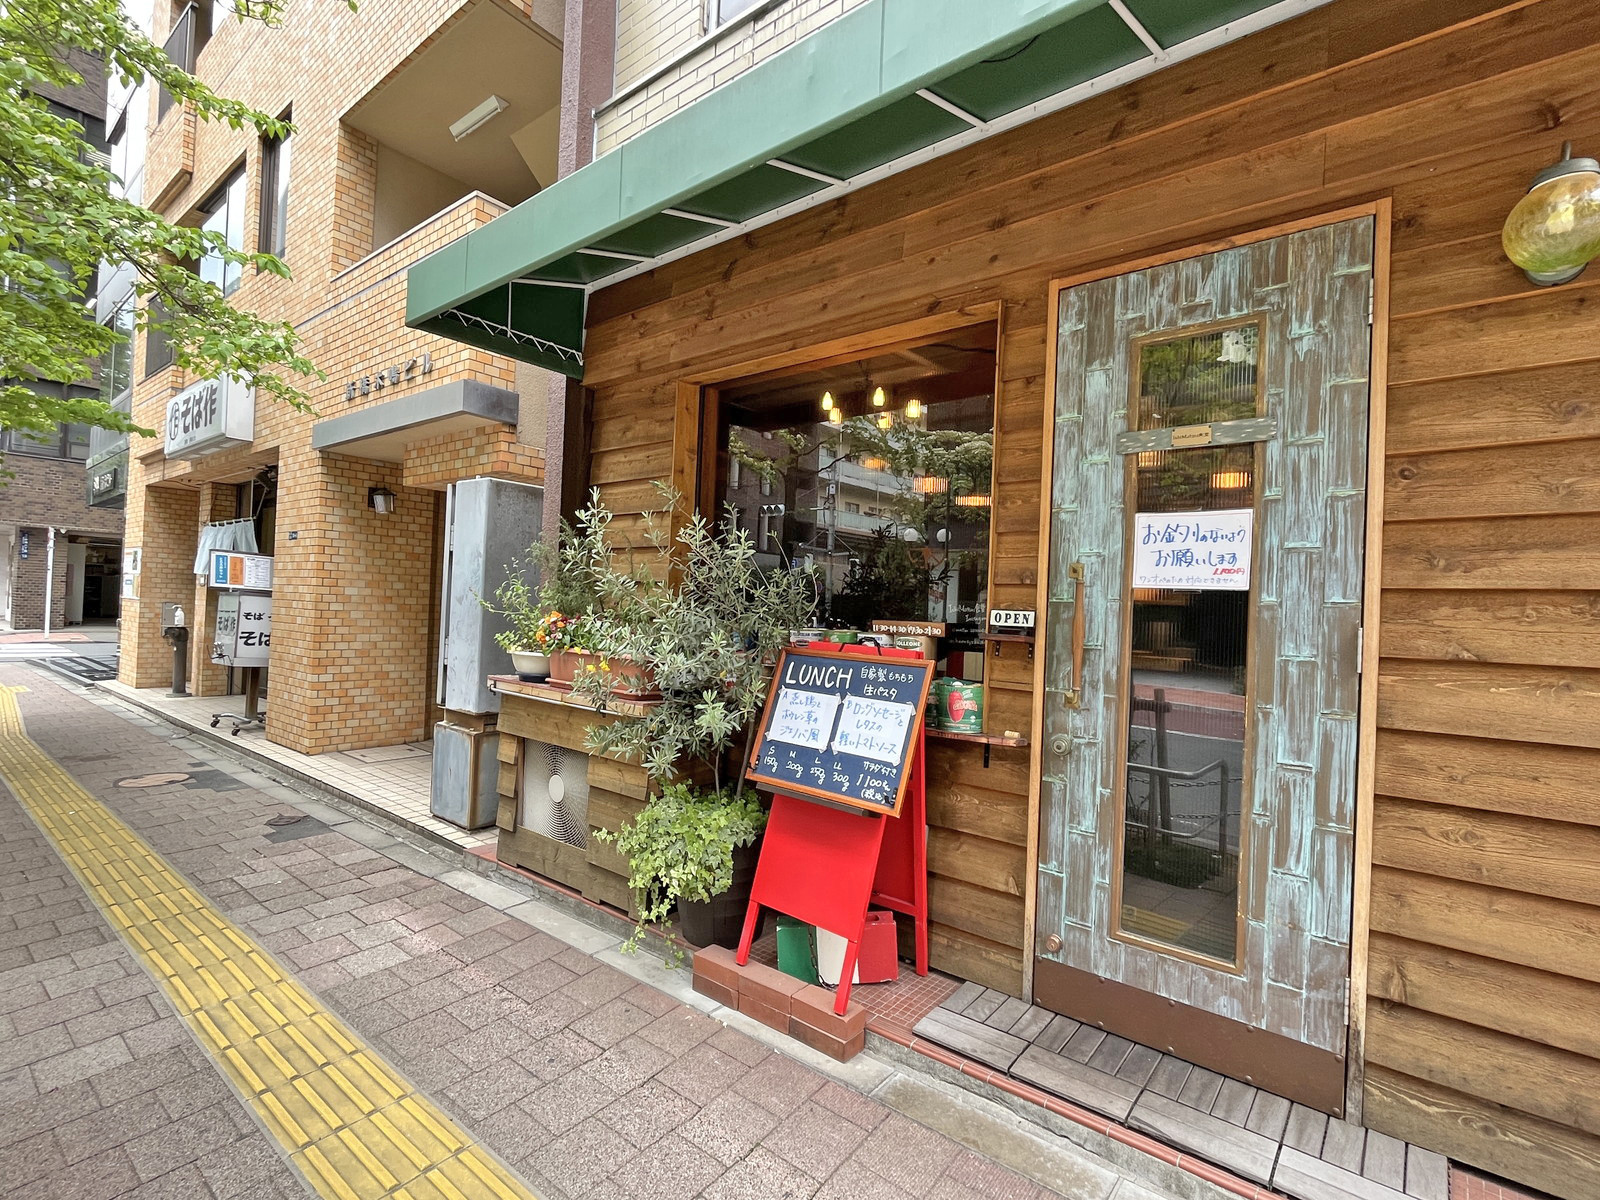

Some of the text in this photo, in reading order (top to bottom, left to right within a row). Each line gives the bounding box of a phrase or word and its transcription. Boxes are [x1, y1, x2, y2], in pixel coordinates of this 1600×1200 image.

[181, 384, 218, 434] そば作
[1142, 523, 1246, 545] お釣りのないよう
[1150, 548, 1238, 567] お願いします
[242, 612, 265, 621] そば
[994, 612, 1030, 624] OPEN
[785, 661, 853, 690] LUNCH
[863, 684, 898, 700] 生パスタ
[768, 746, 775, 755] S
[764, 756, 849, 792] 150g 200g 250g 300g
